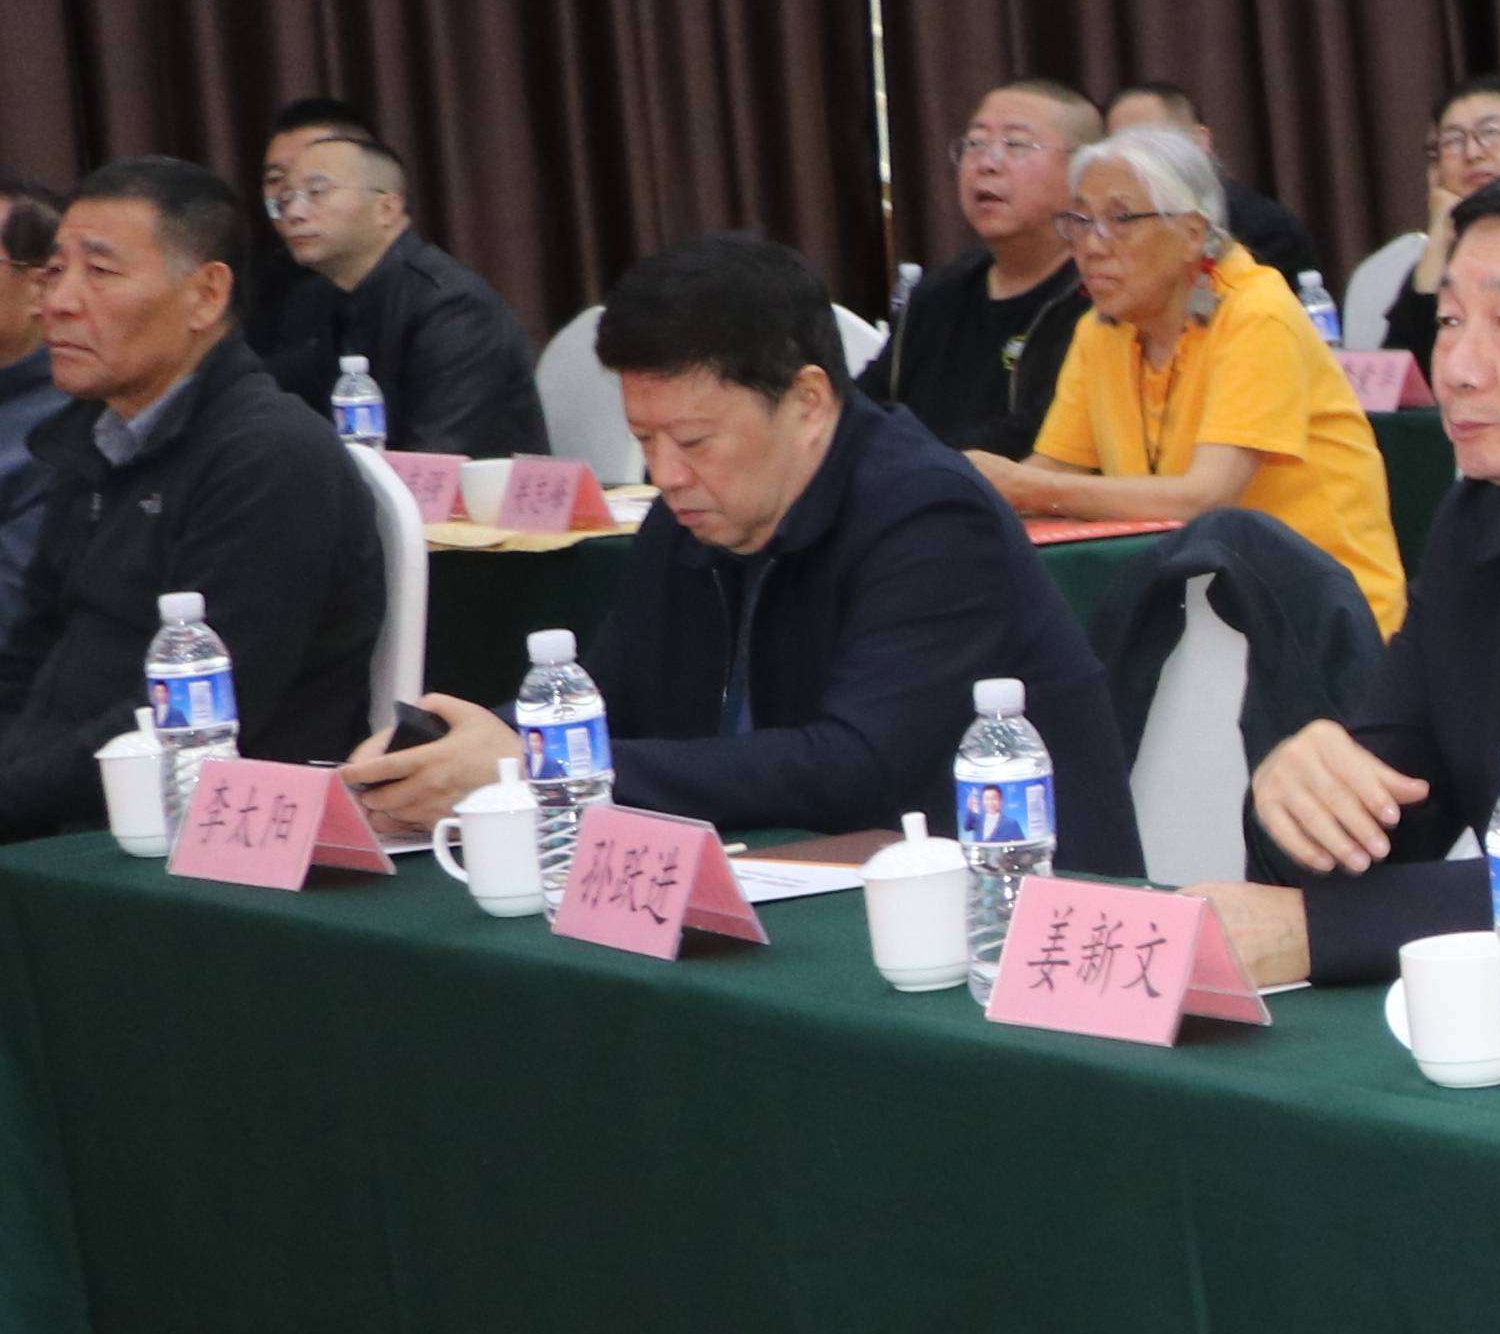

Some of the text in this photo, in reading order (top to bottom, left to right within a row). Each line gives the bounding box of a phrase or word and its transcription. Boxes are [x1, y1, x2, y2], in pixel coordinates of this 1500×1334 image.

[198, 779, 297, 848] 李太阳
[580, 840, 679, 924] 孙跃进
[1026, 907, 1169, 999] 姜新文
